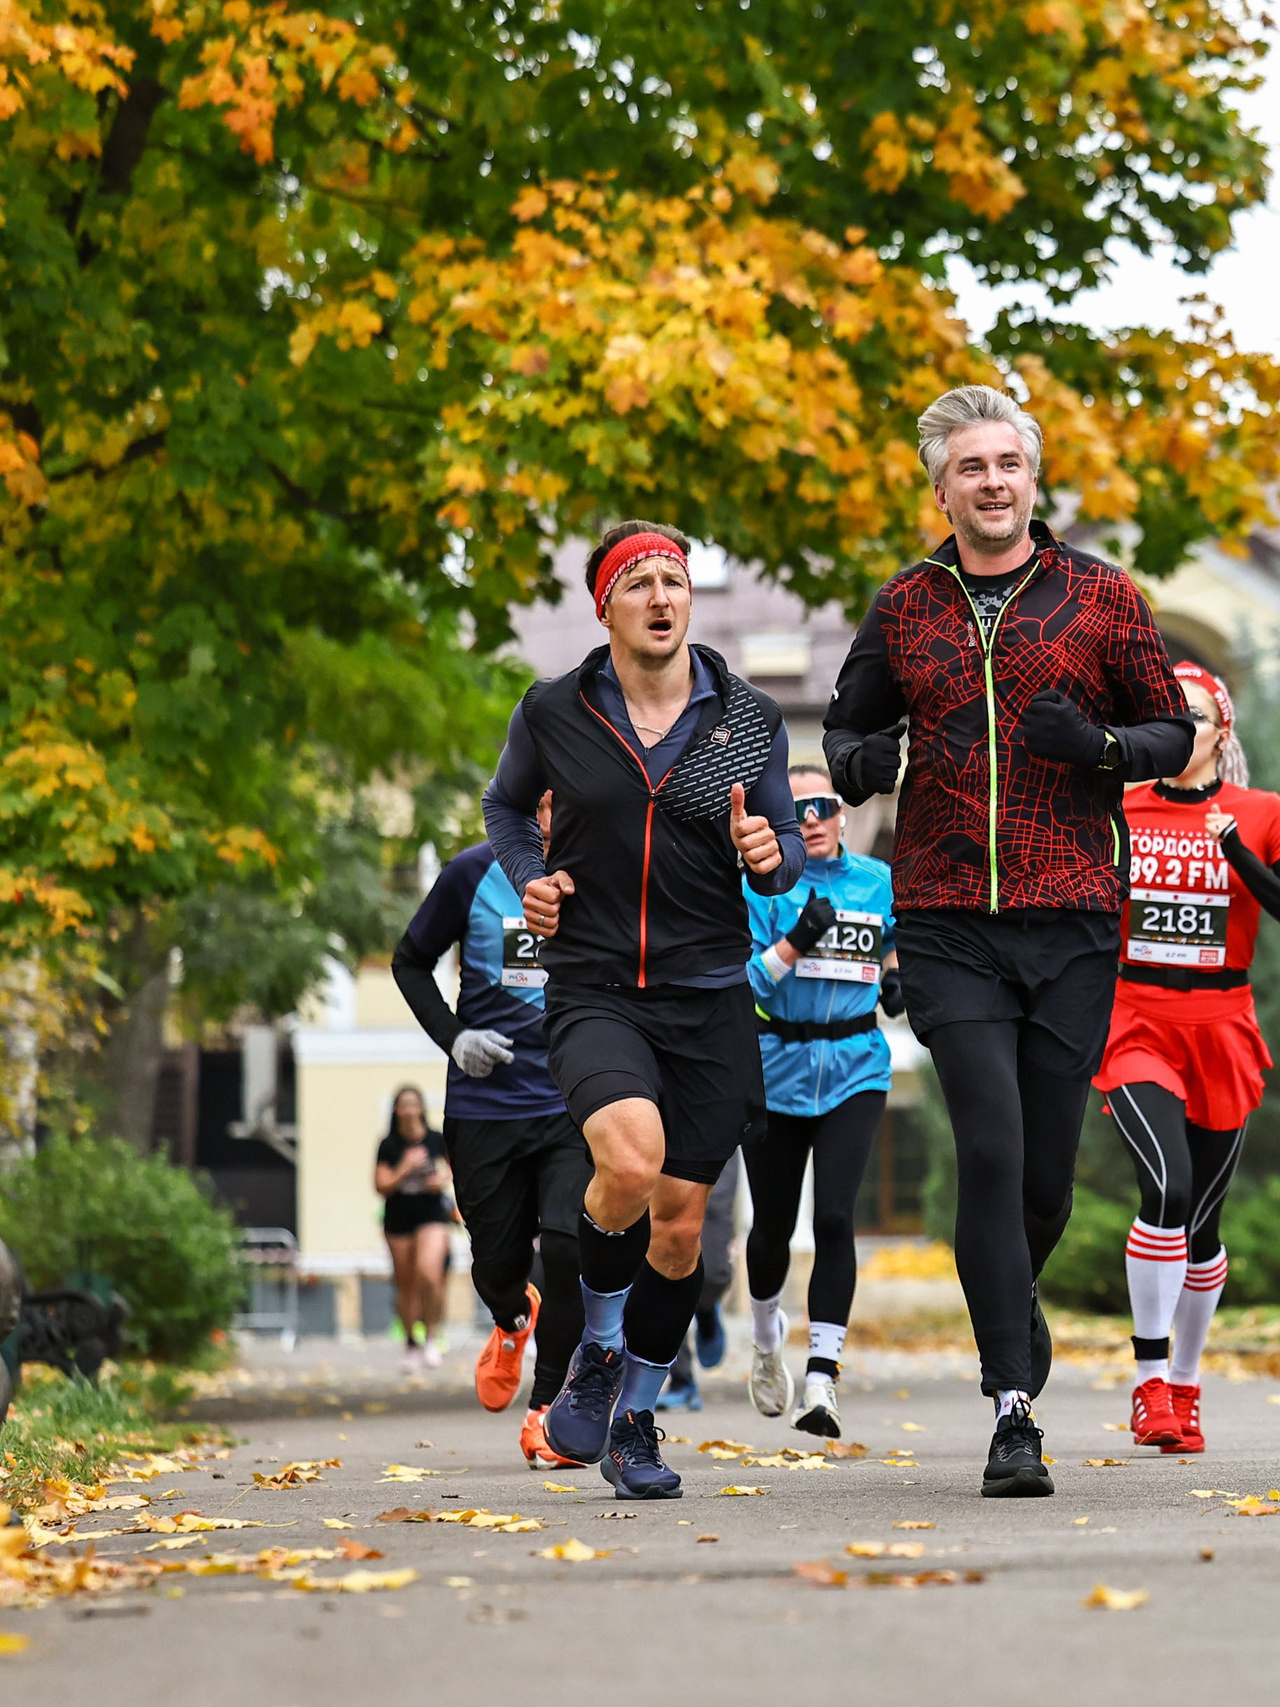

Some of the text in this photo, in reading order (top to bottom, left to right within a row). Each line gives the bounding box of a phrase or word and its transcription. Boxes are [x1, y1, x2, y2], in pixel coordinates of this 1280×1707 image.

[1130, 856, 1229, 890] 89.2 FM
[1142, 905, 1215, 936] 2181
